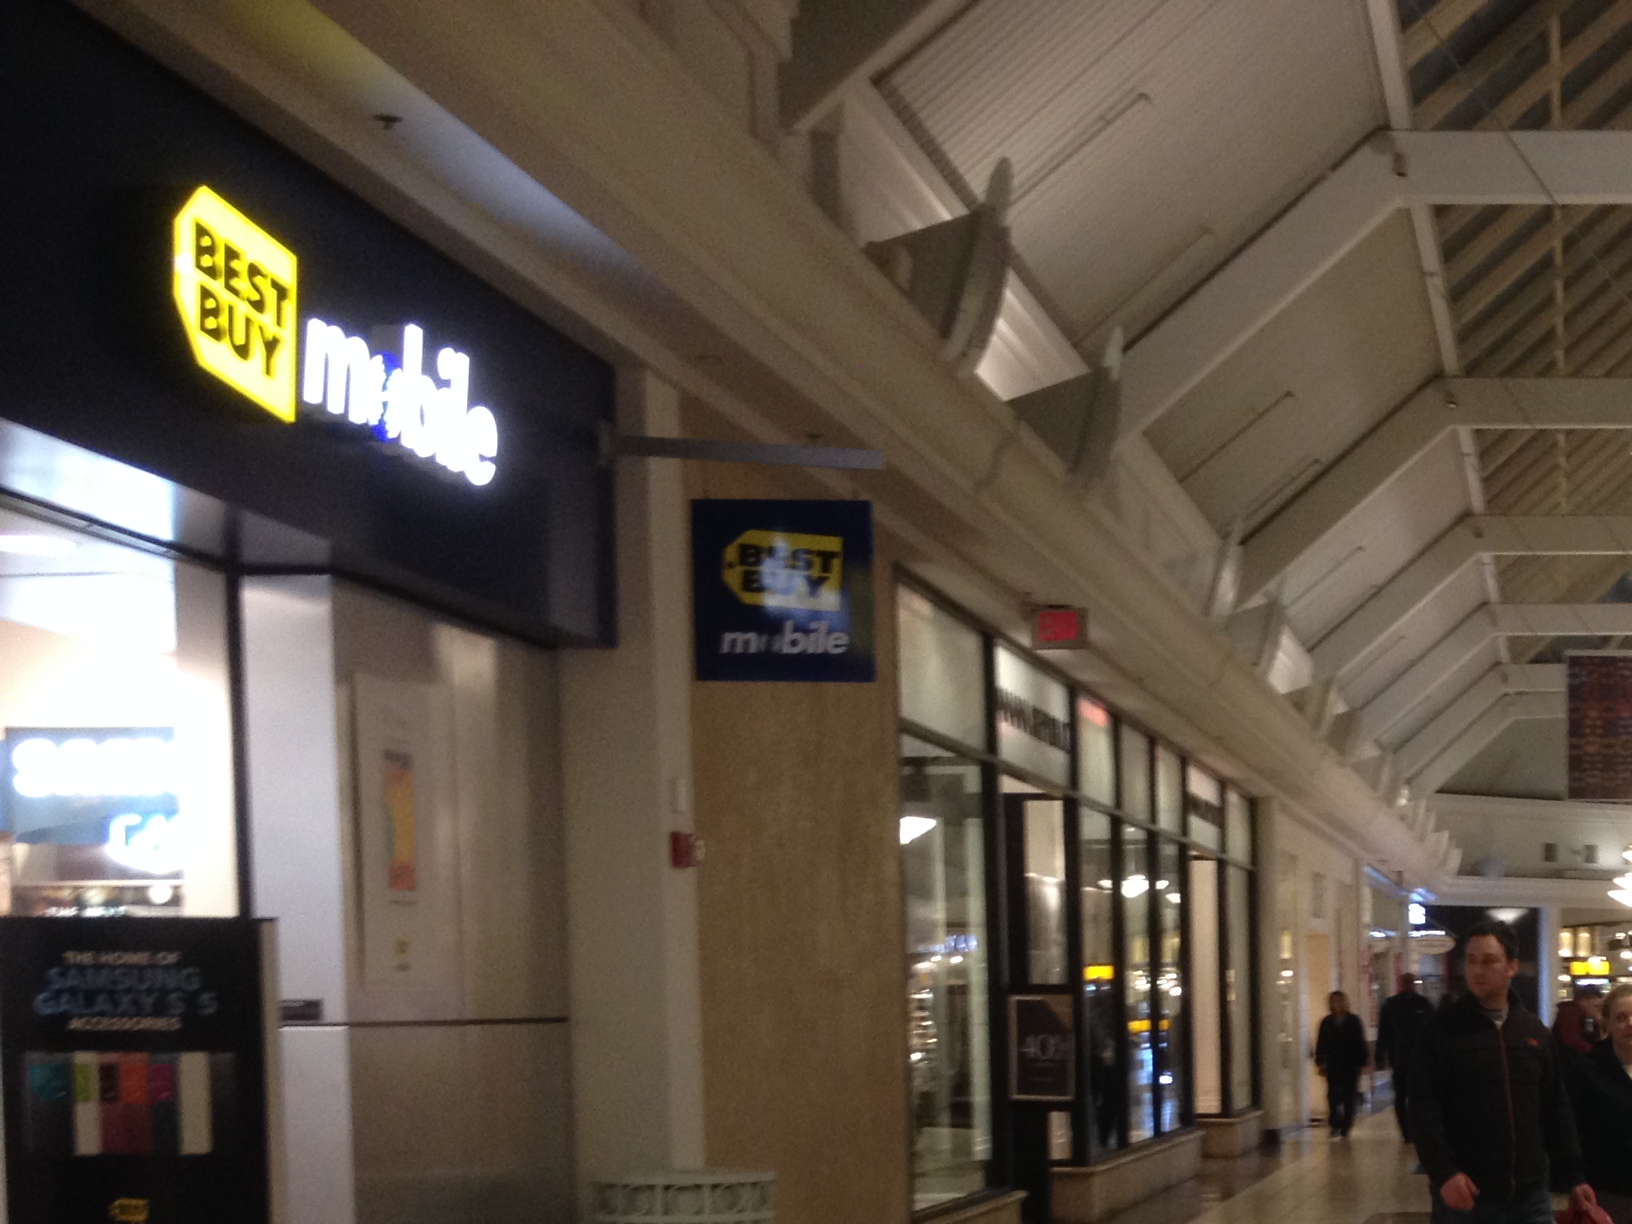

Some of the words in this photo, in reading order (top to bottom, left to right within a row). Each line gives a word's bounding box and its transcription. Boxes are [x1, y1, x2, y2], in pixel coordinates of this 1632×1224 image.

[194, 219, 290, 330] BEST
[199, 283, 280, 380] BUY
[303, 317, 498, 487] mobile
[738, 543, 840, 575] BEST
[742, 569, 831, 598] BUY
[719, 619, 850, 654] mobile
[46, 967, 200, 990] SAMSUNG
[33, 991, 160, 1015] GALAXY
